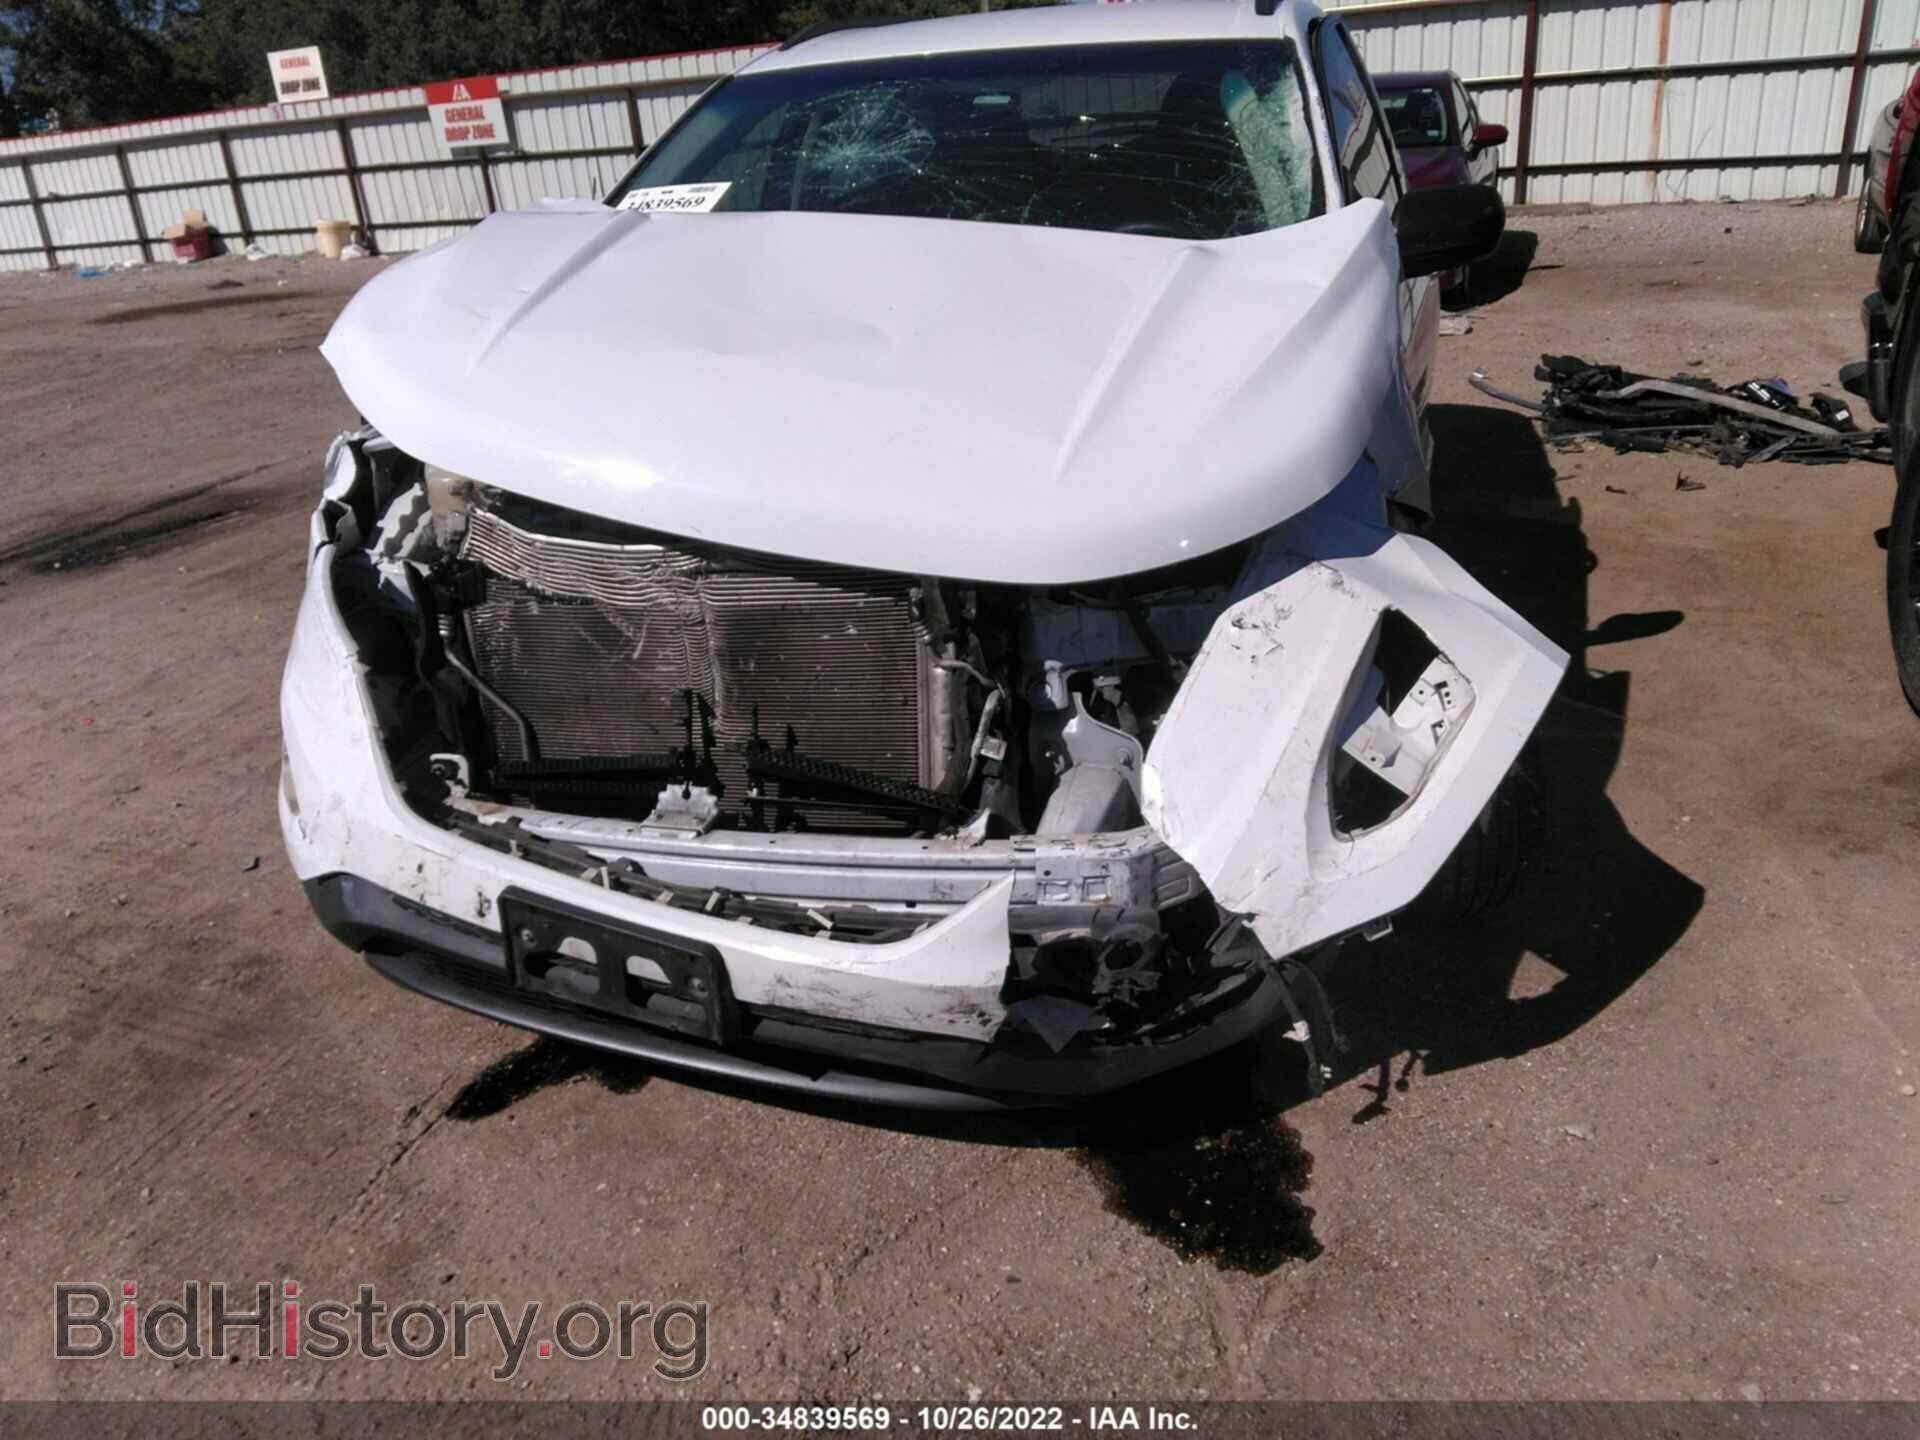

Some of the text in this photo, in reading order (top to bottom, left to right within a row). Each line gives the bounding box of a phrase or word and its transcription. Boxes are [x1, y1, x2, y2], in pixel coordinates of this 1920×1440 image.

[445, 105, 485, 122] GENERAL
[445, 123, 496, 141] DROP ZONE
